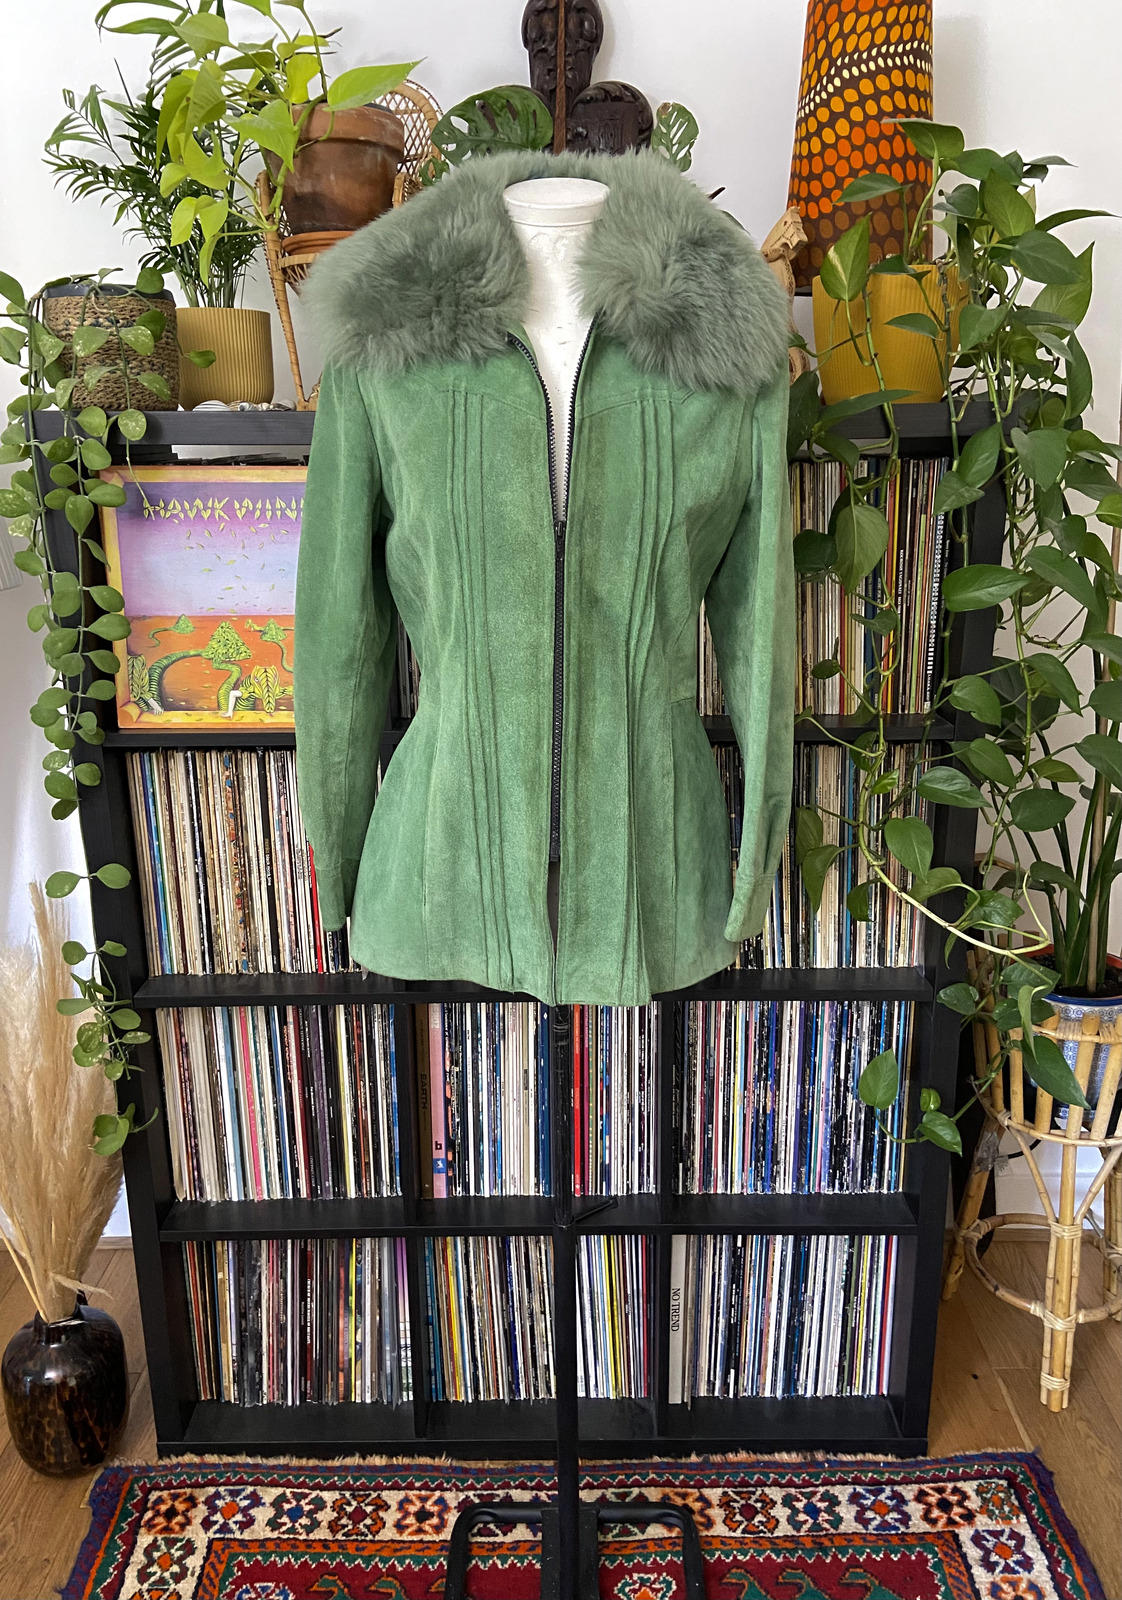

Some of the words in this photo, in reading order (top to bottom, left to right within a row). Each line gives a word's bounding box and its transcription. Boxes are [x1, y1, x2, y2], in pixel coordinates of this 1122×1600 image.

[143, 497, 304, 521] HAWKWIN
[672, 1288, 680, 1301] NO
[671, 1302, 680, 1332] TREND
